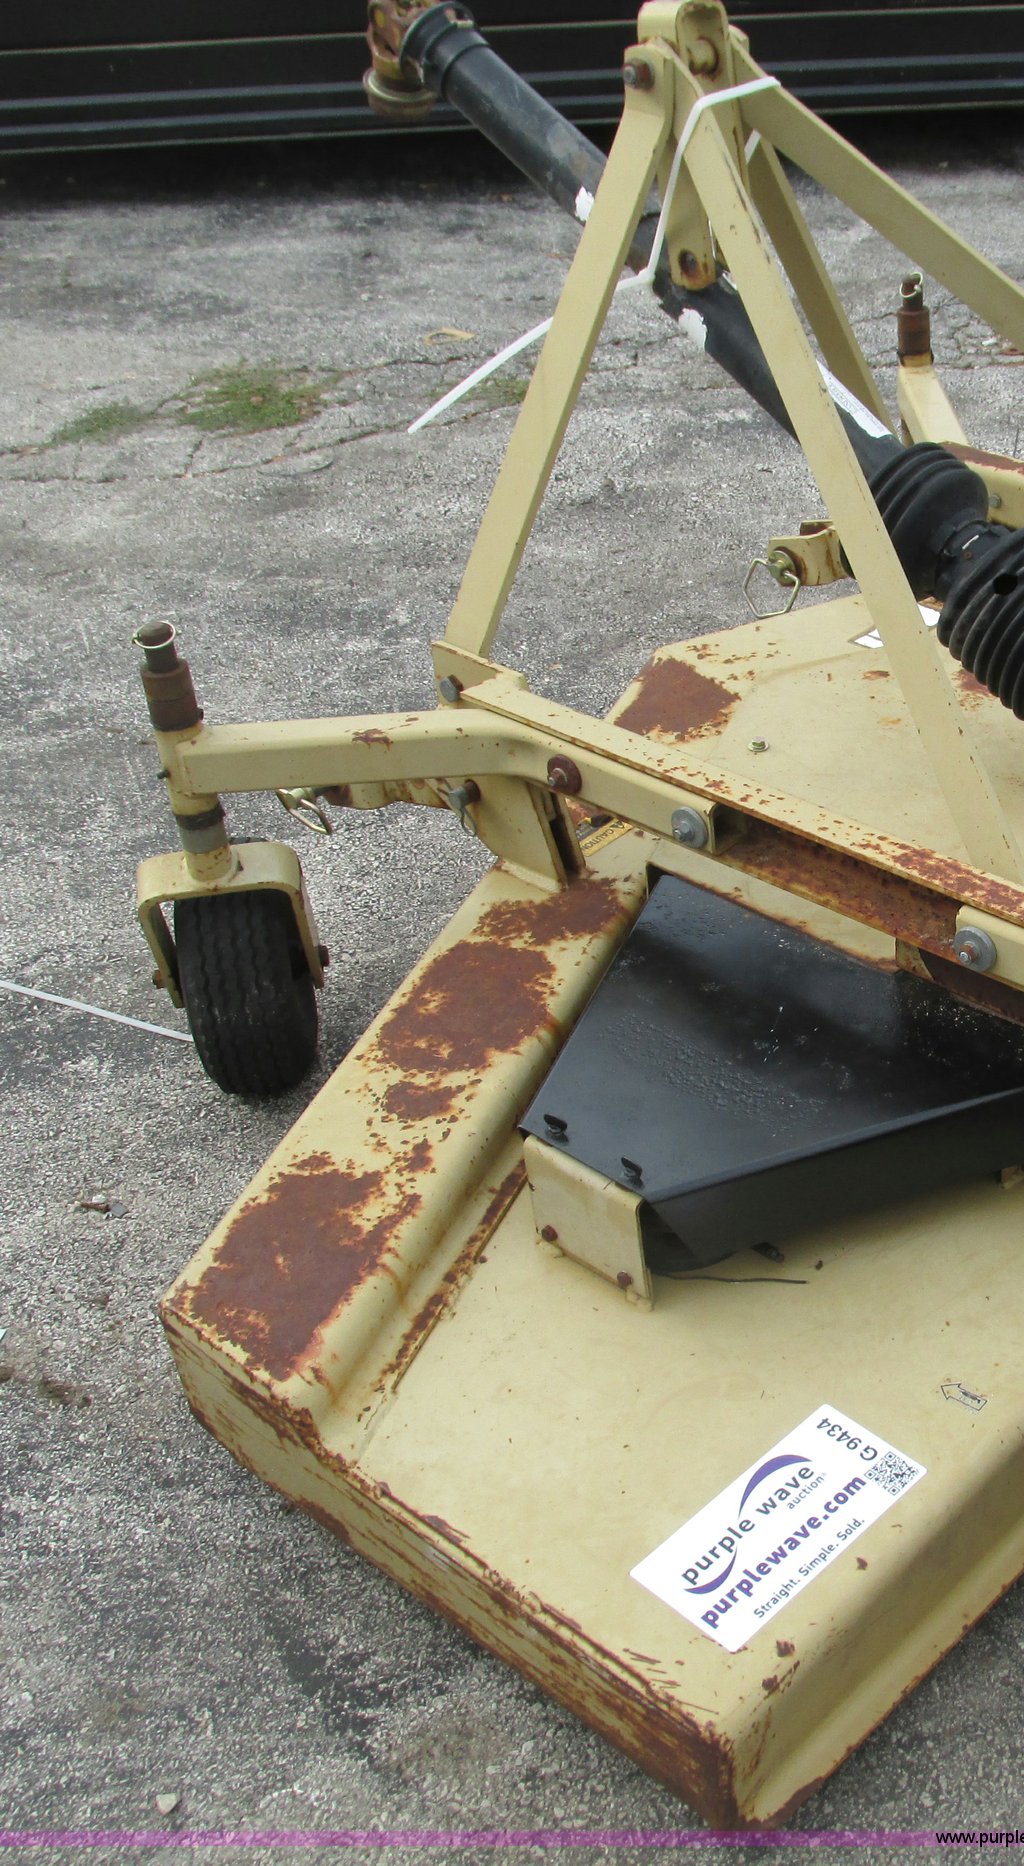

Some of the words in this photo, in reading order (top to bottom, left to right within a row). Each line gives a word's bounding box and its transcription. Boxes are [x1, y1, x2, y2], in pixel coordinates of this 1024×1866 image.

[816, 1418, 862, 1451] 9434
[860, 1445, 878, 1461] G
[681, 1519, 756, 1586] purple
[755, 1466, 815, 1516] wave
[701, 1476, 867, 1629] purplewave.com
[753, 1577, 801, 1619] Straight.
[798, 1543, 840, 1577] Simple.
[836, 1518, 865, 1541] Sold.
